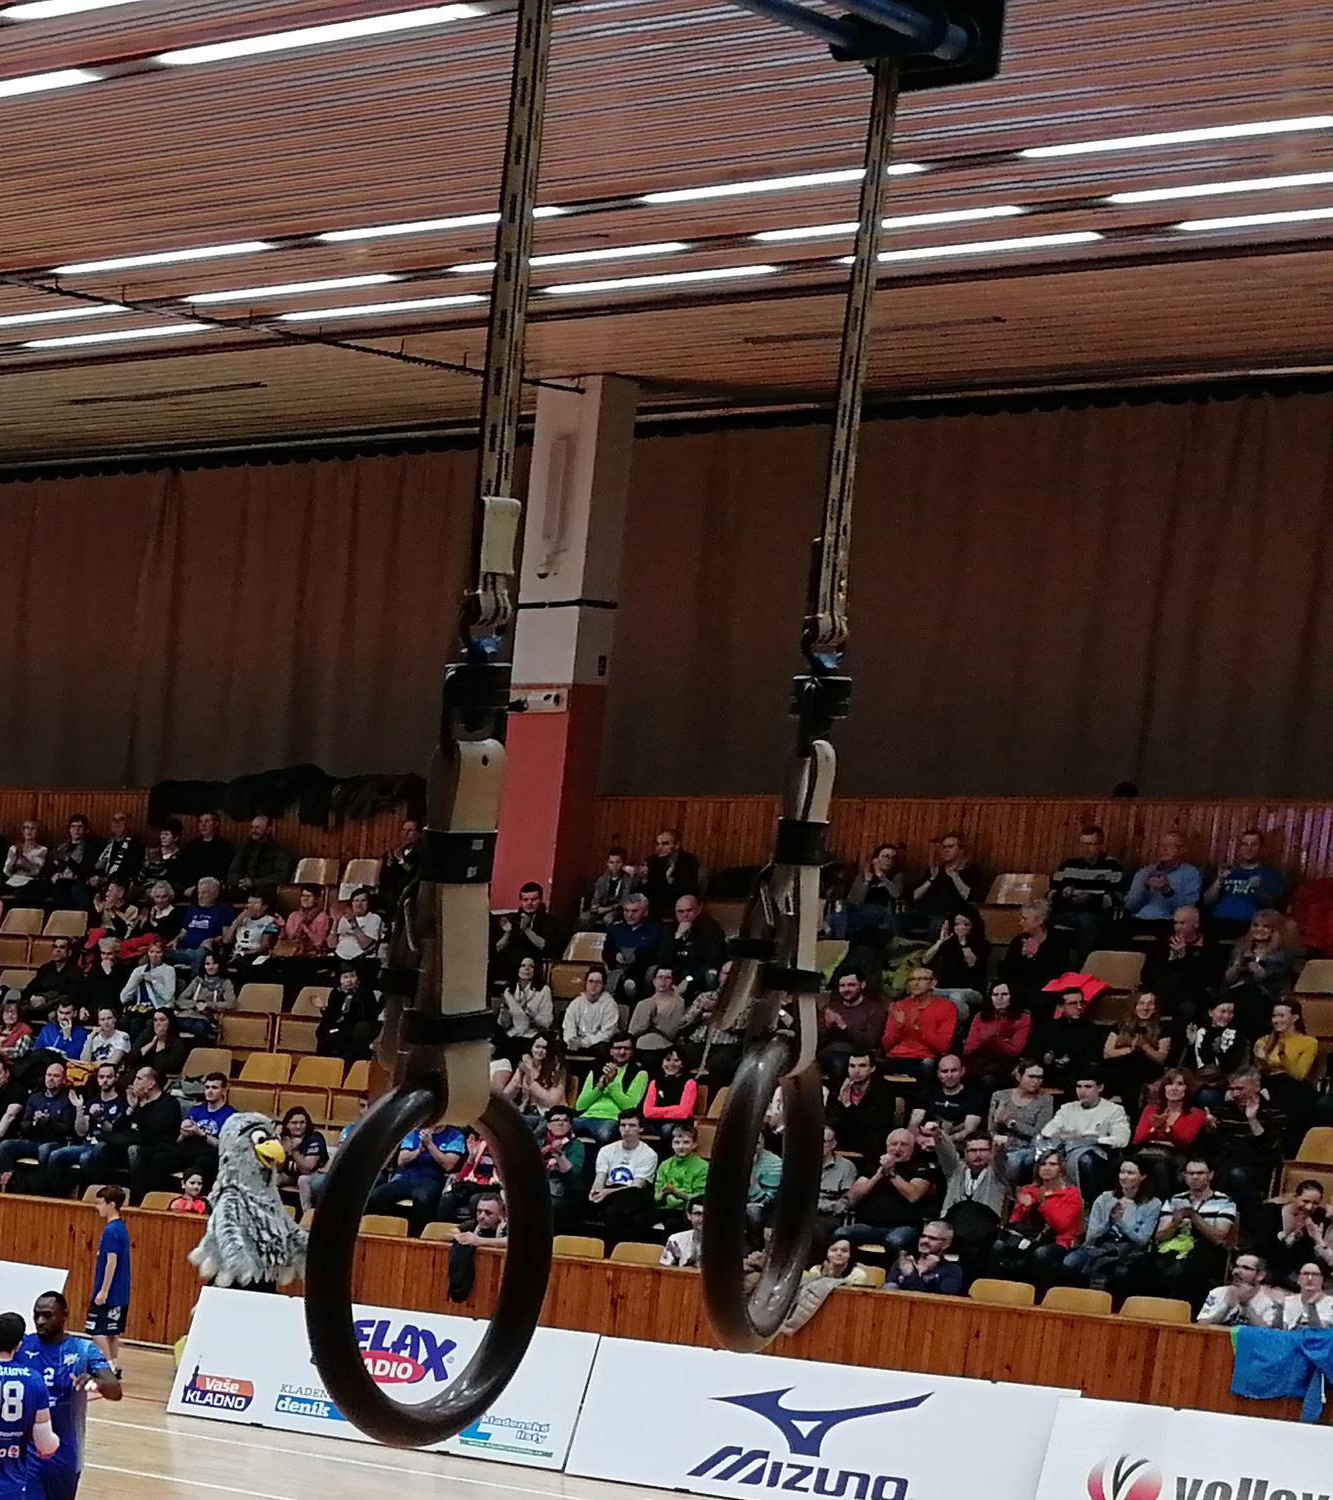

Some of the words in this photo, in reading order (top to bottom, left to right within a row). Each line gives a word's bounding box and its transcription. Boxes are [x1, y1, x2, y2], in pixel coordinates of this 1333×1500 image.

[353, 1319, 457, 1382] ELAX
[364, 1357, 414, 1380] ADIO
[205, 1376, 239, 1393] Vaše
[280, 1384, 329, 1399] KLADEN
[185, 1389, 246, 1409] KLADNO
[277, 1397, 331, 1418] deník
